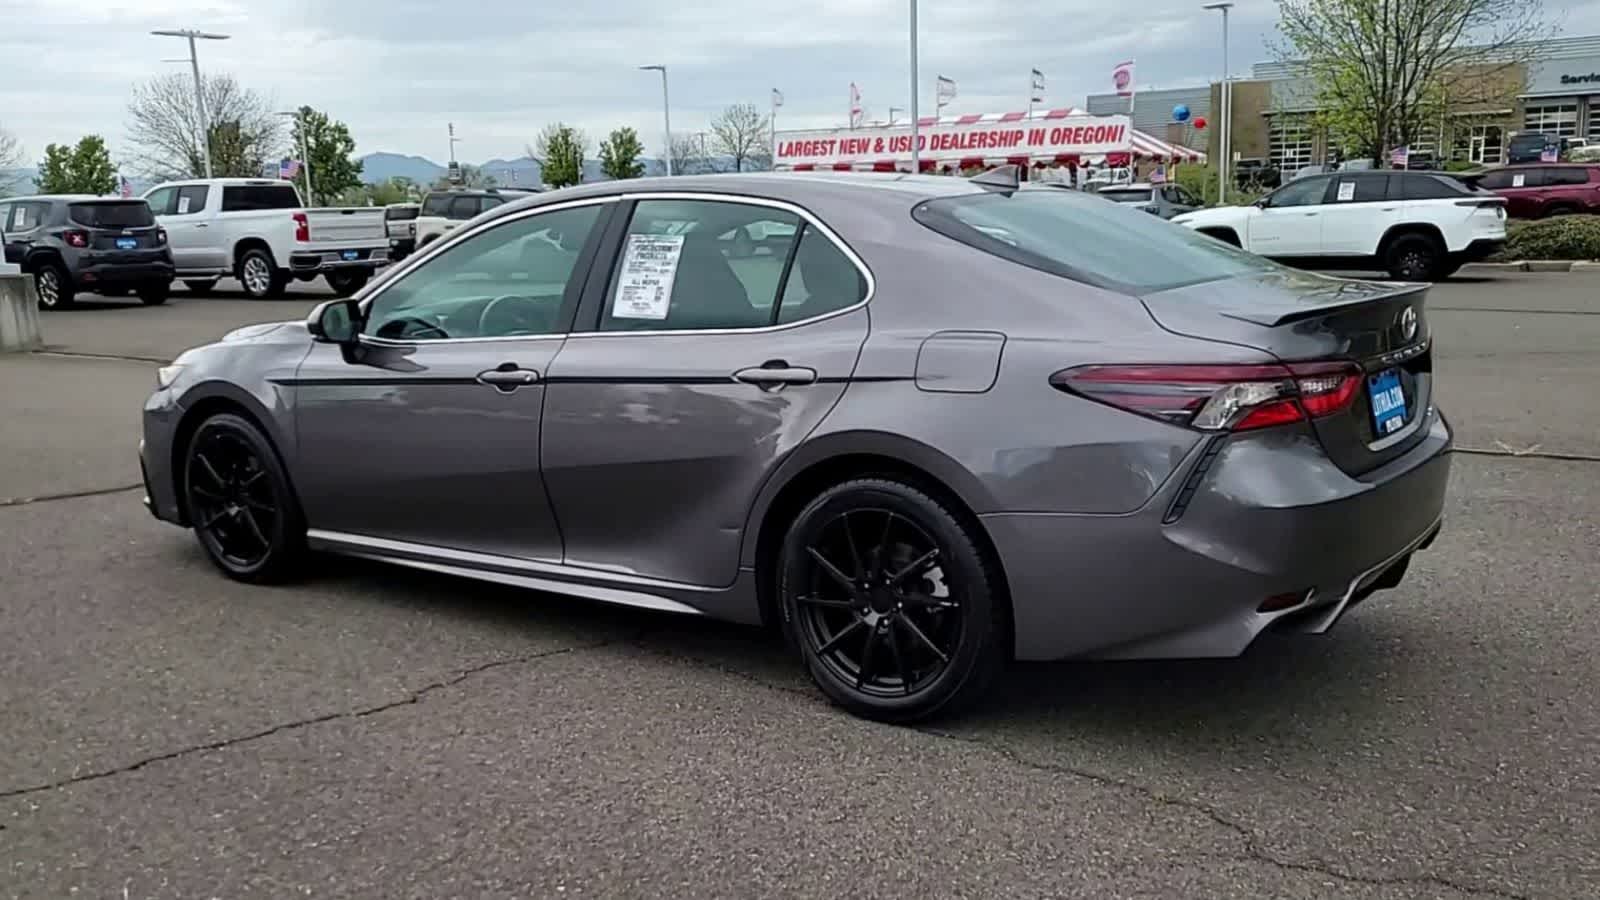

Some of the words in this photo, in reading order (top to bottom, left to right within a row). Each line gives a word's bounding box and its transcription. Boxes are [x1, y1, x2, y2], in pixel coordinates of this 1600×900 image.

[778, 140, 836, 158] LARGEST
[840, 137, 871, 155] NEW
[874, 136, 884, 153] &
[930, 130, 1024, 151] DEALERSHIP
[1027, 128, 1047, 146] IN
[1050, 125, 1125, 146] OREGON!
